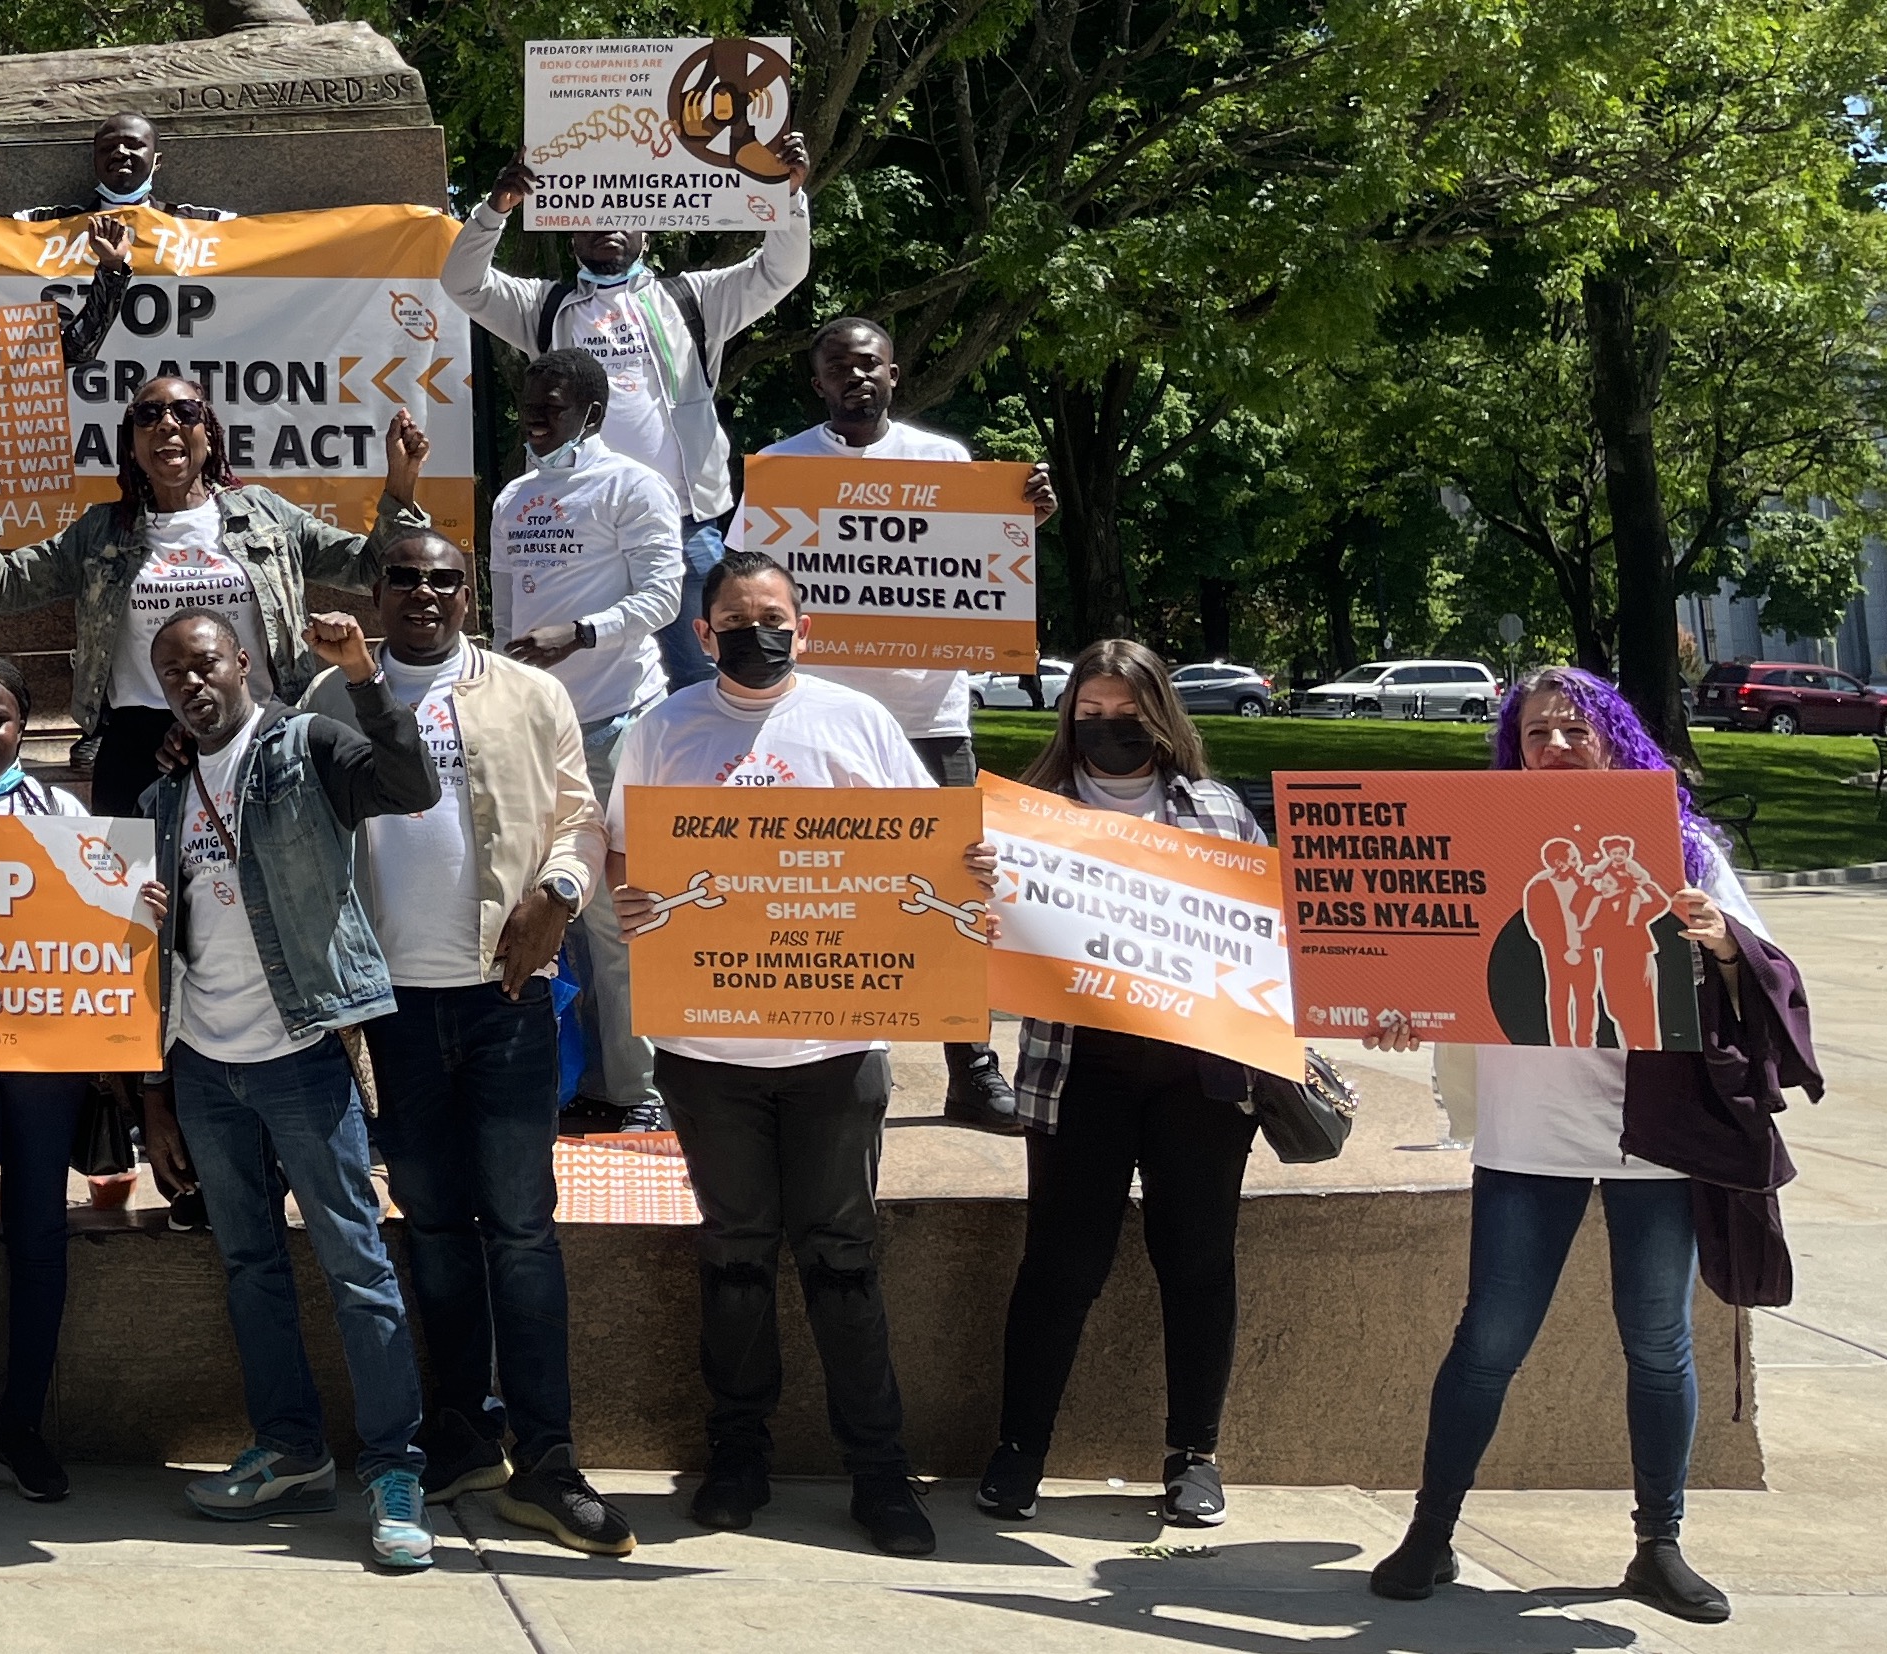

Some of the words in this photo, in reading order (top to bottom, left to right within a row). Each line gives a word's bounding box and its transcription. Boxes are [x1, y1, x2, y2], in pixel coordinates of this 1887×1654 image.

[530, 46, 593, 55] PREDATORY
[596, 44, 673, 54] IMMIGRATION
[540, 60, 571, 69] BOND
[576, 59, 638, 68] COMPANIES
[642, 58, 662, 68] ARE
[552, 75, 597, 84] GETTING
[601, 74, 626, 83] RICH
[630, 74, 650, 82] OFF
[550, 89, 622, 98] IMMIGRANTS'
[626, 88, 652, 97] PAIN
[536, 174, 586, 189] STOP
[593, 173, 740, 188] IMMIGRATION
[536, 194, 595, 209] BOND
[602, 194, 666, 208] ABUSE
[673, 193, 712, 208] ACT
[535, 216, 590, 226] SIMBAA
[596, 215, 646, 226] #A7770
[659, 215, 710, 226] #S7475
[6, 323, 56, 340] WAIT
[8, 342, 58, 358] WAIT
[269, 425, 375, 468] ACT
[837, 482, 894, 506] PASS
[900, 484, 941, 507] THE
[838, 515, 929, 543] STOP
[787, 552, 982, 579] IMMIGRATION
[798, 583, 851, 605] OND
[858, 587, 947, 610] ABUSE
[953, 590, 1006, 611] ACT
[854, 642, 917, 657] #A7770
[932, 645, 995, 661] #S7475
[735, 775, 775, 786] STOP
[766, 753, 796, 783] THE
[1018, 798, 1092, 827] #S7475
[1289, 801, 1407, 827] PROTECT
[672, 815, 739, 839] BREAK
[748, 816, 789, 839] THE
[793, 817, 903, 841] SHACKLES
[909, 817, 939, 839] OF
[1106, 821, 1178, 853] #A7770
[778, 850, 845, 868] DEBT
[999, 841, 1063, 876] ACT
[1185, 844, 1267, 875] SIMBAA
[1291, 835, 1451, 861] IMMIGRANT
[714, 875, 907, 894] SURVEILLANCE
[1069, 861, 1172, 907] ABUSE
[1295, 868, 1359, 893] NEW
[1362, 869, 1487, 896] YORKERS
[766, 902, 856, 920] SHAME
[1023, 879, 1253, 967] IMMIGRATION
[1178, 894, 1274, 940] BOND
[1298, 901, 1369, 927] PASS
[1375, 903, 1479, 929] NY4ALL
[769, 930, 809, 946] PASS
[815, 930, 844, 946] THE
[693, 951, 749, 968] STOP
[756, 952, 915, 970] IMMIGRATION
[1084, 932, 1194, 985] STOP
[1300, 945, 1388, 957] #PASSNY4ALL
[712, 972, 777, 989] BOND
[783, 973, 854, 990] ABUSE
[860, 974, 903, 990] ACT
[1064, 966, 1117, 1001] THE
[71, 988, 135, 1016] ACT
[1125, 979, 1195, 1018] PASS
[683, 1008, 761, 1024] SIMBAA
[766, 1010, 834, 1026] #A7770
[851, 1011, 920, 1027] #S7475
[1329, 1006, 1369, 1027] NYIC
[1411, 1011, 1431, 1020] NEW
